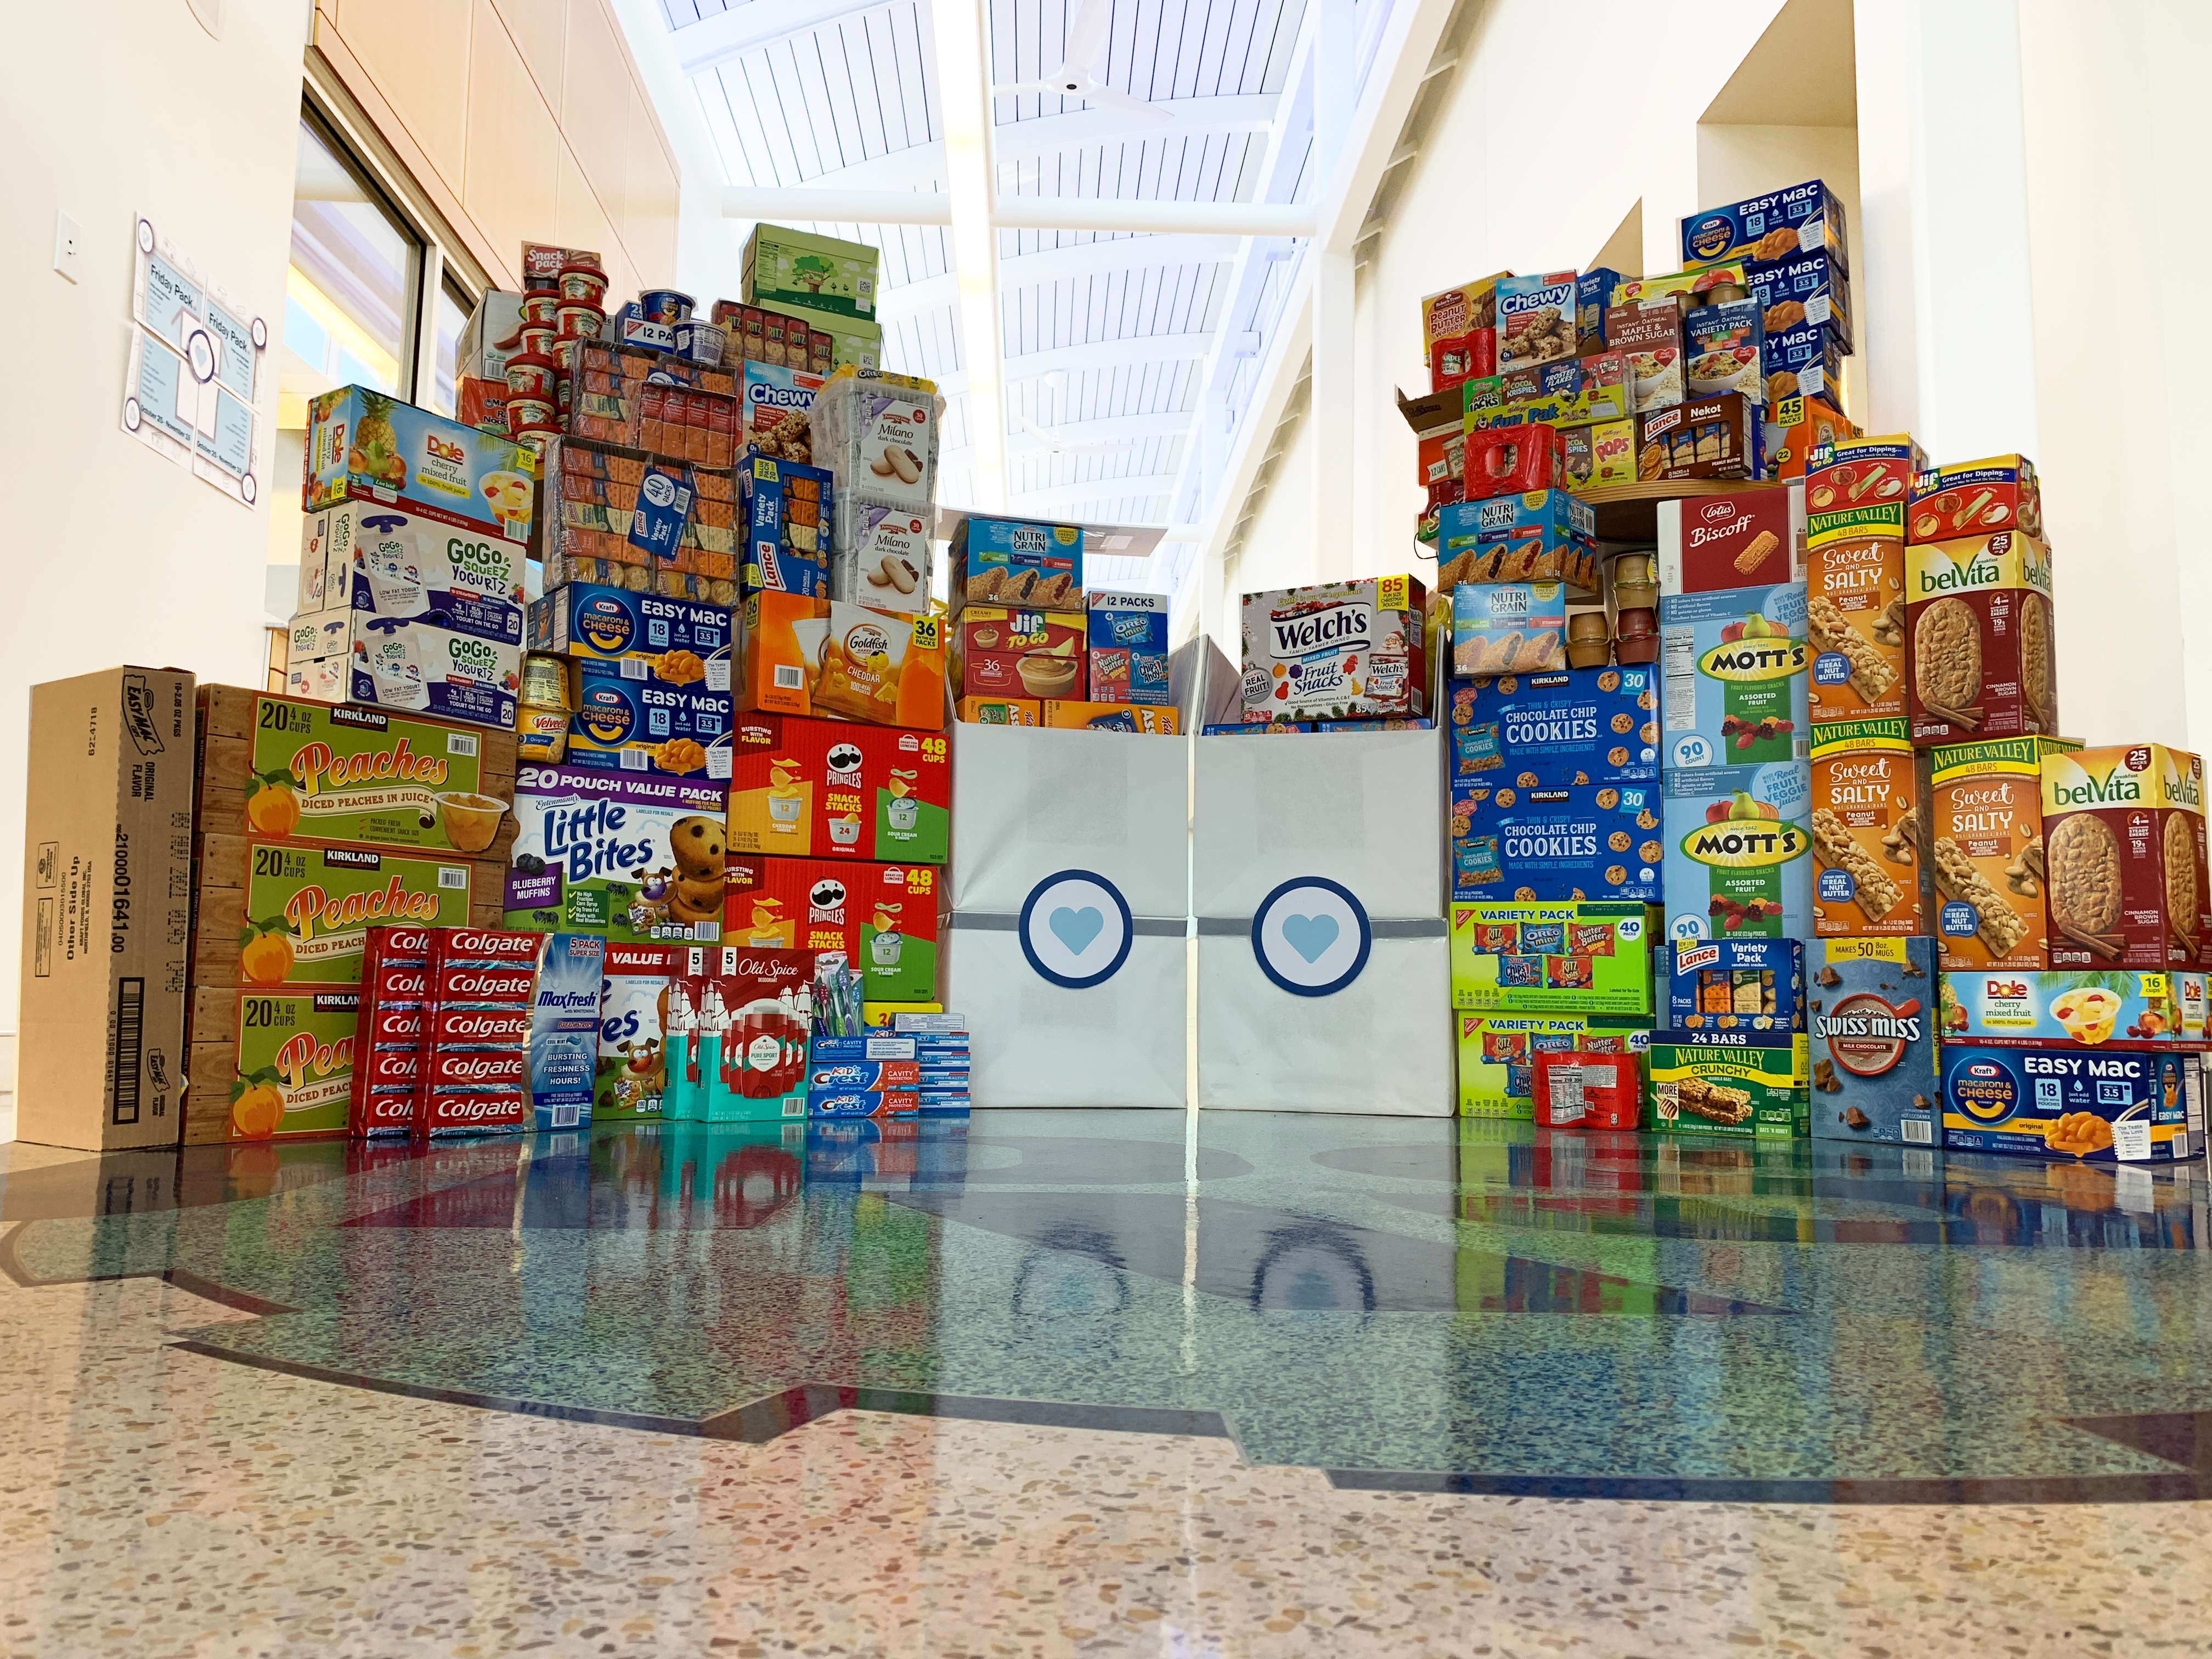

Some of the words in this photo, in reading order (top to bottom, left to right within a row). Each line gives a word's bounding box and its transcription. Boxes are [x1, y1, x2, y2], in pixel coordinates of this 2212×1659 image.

[528, 249, 563, 262] Snack
[535, 259, 562, 270] pack
[151, 264, 173, 294] Friday
[174, 284, 193, 308] Pack
[1579, 276, 1600, 289] Variety
[1583, 284, 1598, 294] Pack
[1501, 285, 1571, 314] Chewy
[209, 313, 229, 339] Friday
[230, 330, 247, 354] Pack
[643, 327, 654, 338] 12
[1622, 325, 1652, 336] MAPLE
[1690, 323, 1727, 337] VARIETY
[1729, 319, 1752, 329] PACK
[789, 331, 806, 346] RITZ
[1610, 334, 1643, 347] BROWN
[1645, 329, 1675, 340] SUGAR
[1545, 368, 1576, 382] FROSTED
[1547, 376, 1572, 388] FLAKES
[1506, 386, 1537, 398] KRISPIES
[1511, 380, 1533, 390] COCOA
[1690, 404, 1722, 417] Nekot
[1780, 399, 1802, 415] 45
[1492, 414, 1523, 428] Fun
[1528, 403, 1560, 422] Pak
[878, 424, 913, 438] Milano
[894, 436, 913, 445] chocolate
[427, 435, 464, 462] Dole
[1594, 438, 1630, 463] POPS
[1837, 448, 1855, 458] Great
[521, 452, 532, 463] 16
[431, 458, 458, 473] cherry
[421, 466, 447, 481] mixed
[448, 471, 467, 487] fruit
[427, 478, 440, 488] 100%
[441, 482, 452, 492] fruit
[453, 486, 466, 495] juice
[648, 479, 665, 498] 40
[662, 484, 673, 503] PACKS
[1706, 505, 1731, 518] Lotus
[636, 511, 647, 536] Lance
[1810, 512, 1854, 534] NATURE
[1856, 505, 1898, 524] VALLEY
[1014, 531, 1045, 542] NUTRI
[1690, 515, 1752, 548] Biscoff
[1838, 527, 1847, 537] 48
[1849, 526, 1869, 535] BARS
[1013, 540, 1046, 552] GRAIN
[1993, 535, 2007, 546] 25
[1822, 541, 1884, 570] Sweet
[463, 560, 509, 582] SQUEEZ
[765, 543, 780, 588] Lance
[1921, 554, 2000, 592] belVita
[452, 565, 506, 595] YOGURTZ
[1382, 578, 1403, 592] 85
[1824, 568, 1883, 590] SALTY
[1107, 596, 1116, 606] 12
[1120, 597, 1154, 607] PACKS
[508, 619, 518, 630] 20
[652, 623, 665, 635] 18
[915, 620, 936, 637] 36
[1009, 614, 1043, 633] Jif
[1115, 619, 1147, 634] OREO
[1124, 625, 1145, 637] mini
[1274, 608, 1367, 650] Welch's
[849, 635, 889, 651] Goldfish
[915, 639, 935, 647] PACKS
[1007, 635, 1027, 648] TO
[1029, 633, 1048, 644] GO
[1308, 641, 1329, 651] FARMER
[1330, 636, 1350, 645] OWNED
[1098, 653, 1121, 667] Nutter
[1302, 654, 1320, 663] MIXED
[1321, 650, 1338, 658] FRUIT
[1710, 648, 1805, 672] MOTT'S
[1102, 658, 1125, 675] Butter
[1304, 662, 1338, 681] Fruit
[847, 666, 880, 683] CHEDDAR
[1245, 675, 1265, 687] REAL
[1532, 676, 1569, 685] KIRKLAND
[1624, 674, 1644, 689] 30
[1244, 681, 1269, 695] FRUIT!
[1294, 674, 1344, 695] Snacks
[174, 682, 182, 708] 10-2.05
[127, 685, 142, 721] EASY
[135, 714, 156, 742] MAC
[174, 709, 182, 719] OZ
[260, 702, 287, 732] 20
[290, 707, 297, 719] 4
[302, 712, 312, 723] OZ
[333, 708, 387, 725] KIRKLAND
[1505, 709, 1568, 724] CHOCOLATE
[1570, 707, 1597, 718] CHIP
[289, 721, 311, 734] CUPS
[535, 717, 567, 731] Velveeta
[741, 726, 772, 735] BURSTING
[1506, 719, 1597, 743] COOKIES
[741, 736, 771, 744] FLAVOR
[921, 737, 946, 754] 48
[1680, 741, 1703, 759] 90
[922, 754, 945, 763] CUPS
[290, 737, 449, 797] Peaches
[132, 764, 143, 798] FLAVOR
[144, 761, 155, 802] ORIGINAL
[516, 768, 558, 789] 20
[560, 776, 621, 792] POUCH
[626, 782, 676, 797] VALUE
[680, 787, 723, 802] PACK
[826, 769, 861, 789] PRINGLES
[302, 799, 335, 809] DICED
[337, 795, 384, 808] PEACHES
[387, 794, 398, 803] IN
[827, 793, 860, 804] SNACK
[825, 802, 862, 812] STACKS
[544, 797, 626, 858] Little
[70, 856, 80, 876] Up
[567, 838, 653, 884] Bites
[512, 876, 556, 889] BLUEBERRY
[68, 880, 77, 912] Side
[517, 888, 551, 900] MUFFINS
[1480, 911, 1535, 919] VARIETY
[1539, 911, 1575, 919] PACK
[66, 918, 76, 961] Other
[452, 932, 533, 955] Colgate
[571, 939, 577, 949] 5
[579, 940, 600, 949] PACK
[1835, 945, 1856, 953] MAKES
[1857, 943, 1874, 956] 50
[725, 952, 733, 964] 5
[738, 958, 763, 975] Old
[764, 959, 797, 975] Spice
[538, 991, 596, 1008] MaxFresh
[1815, 1016, 1866, 1039] SWISS
[1871, 1017, 1920, 1041] MISS
[1692, 1034, 1707, 1043] 24
[1711, 1034, 1746, 1045] BARS
[1675, 1048, 1720, 1067] NATURE
[1722, 1050, 1764, 1070] VALLEY
[832, 1065, 861, 1075] KID'S
[1691, 1065, 1751, 1077] CRUNCHY
[1974, 1066, 1993, 1075] Kraft
[814, 1071, 868, 1086] Crest
